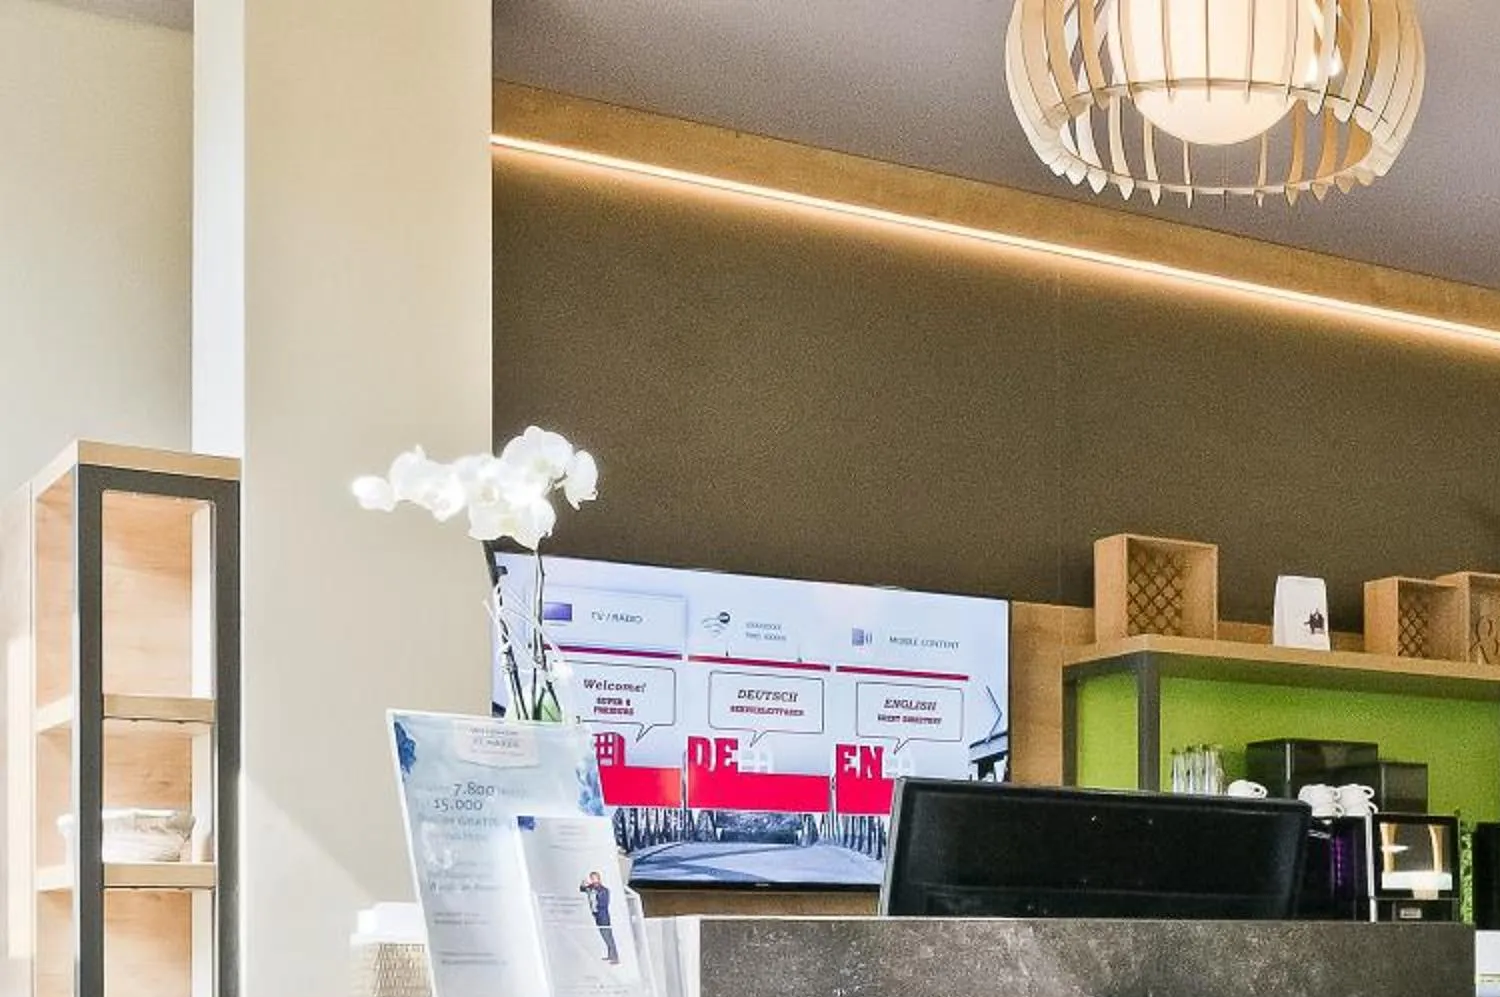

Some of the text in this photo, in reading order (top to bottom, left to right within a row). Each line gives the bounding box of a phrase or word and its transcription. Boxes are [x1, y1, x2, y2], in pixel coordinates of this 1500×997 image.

[583, 679, 647, 693] Welcome!
[737, 690, 799, 703] DEUTSCH
[883, 698, 937, 711] ENGLISH
[688, 736, 739, 772] DE
[836, 744, 885, 779] EN
[433, 799, 483, 813] 15.000
